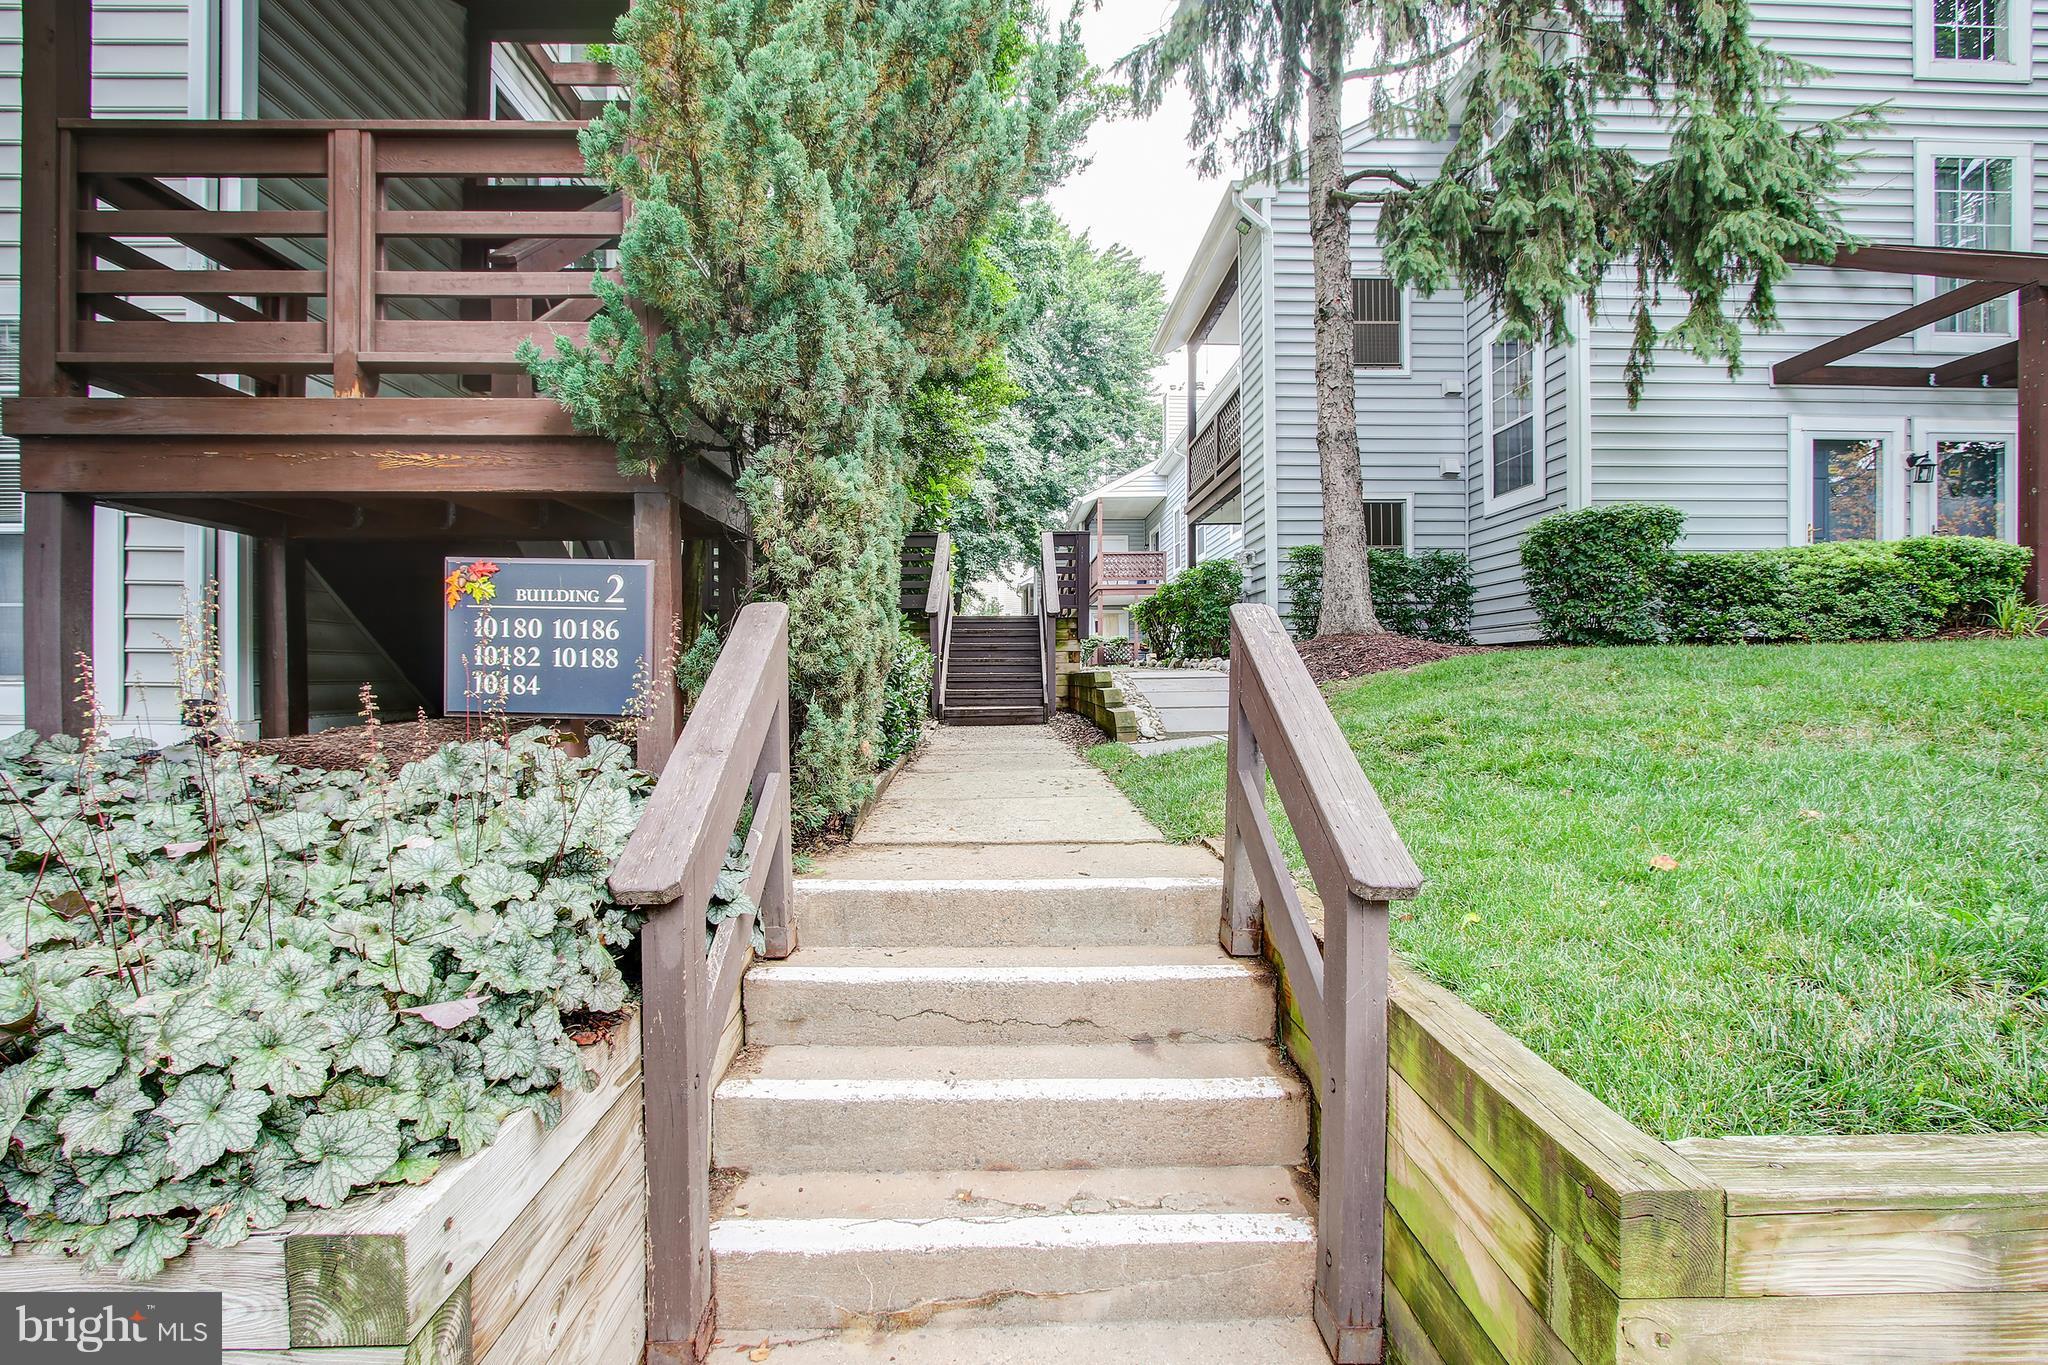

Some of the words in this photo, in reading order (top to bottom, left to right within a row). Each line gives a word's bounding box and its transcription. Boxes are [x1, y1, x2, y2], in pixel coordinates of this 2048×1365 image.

[515, 588, 600, 603] BUILDING
[604, 573, 625, 604] 2
[473, 617, 543, 639] 10180
[552, 618, 620, 641] 10186
[473, 645, 541, 668] 10182
[552, 647, 619, 669] 10188
[473, 673, 541, 696] 10184
